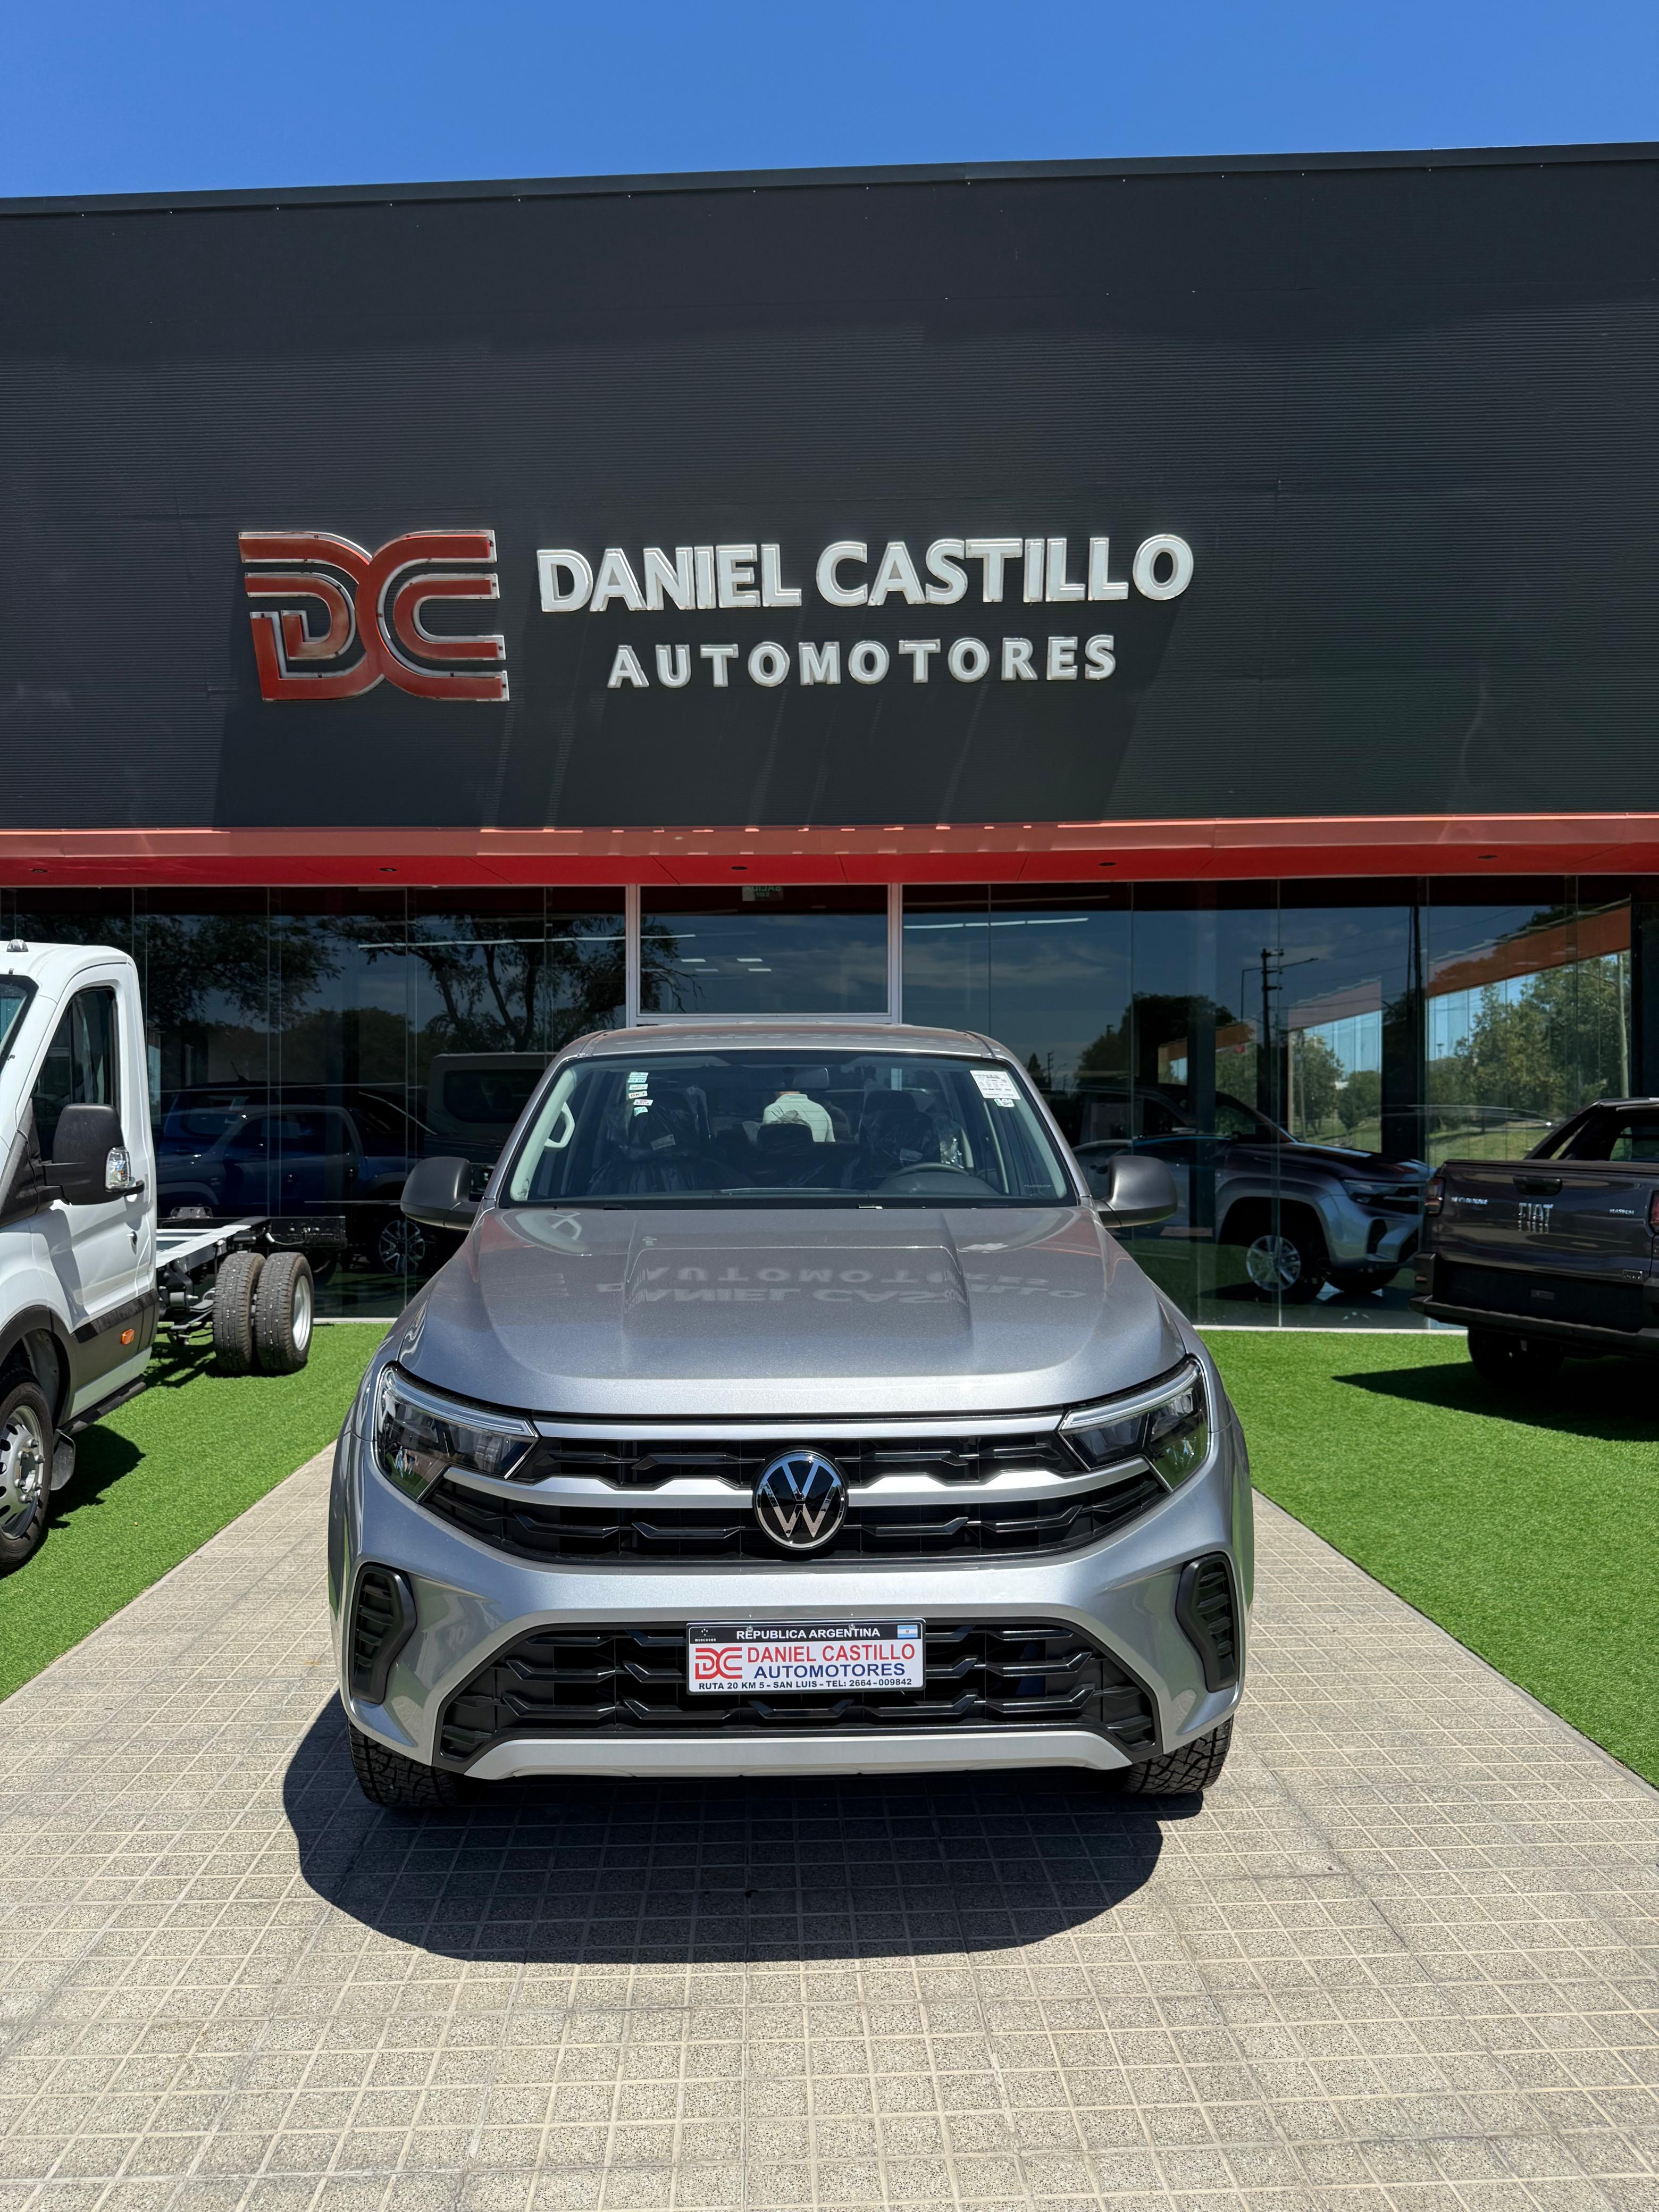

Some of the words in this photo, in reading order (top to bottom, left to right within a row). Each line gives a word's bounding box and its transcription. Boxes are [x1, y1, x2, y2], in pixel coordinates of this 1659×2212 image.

[536, 543, 802, 612] DANIEL
[816, 534, 1194, 607] CASTILLO
[607, 634, 1116, 688] AUTOMOTORES
[1519, 1202, 1554, 1229] FIAT
[736, 1630, 807, 1639] REPUBLICA
[809, 1628, 881, 1638] ARGENTINA
[748, 1646, 816, 1663] DANIEL
[822, 1644, 915, 1662] CASTILLO
[753, 1663, 905, 1679] AUTOMOTORES
